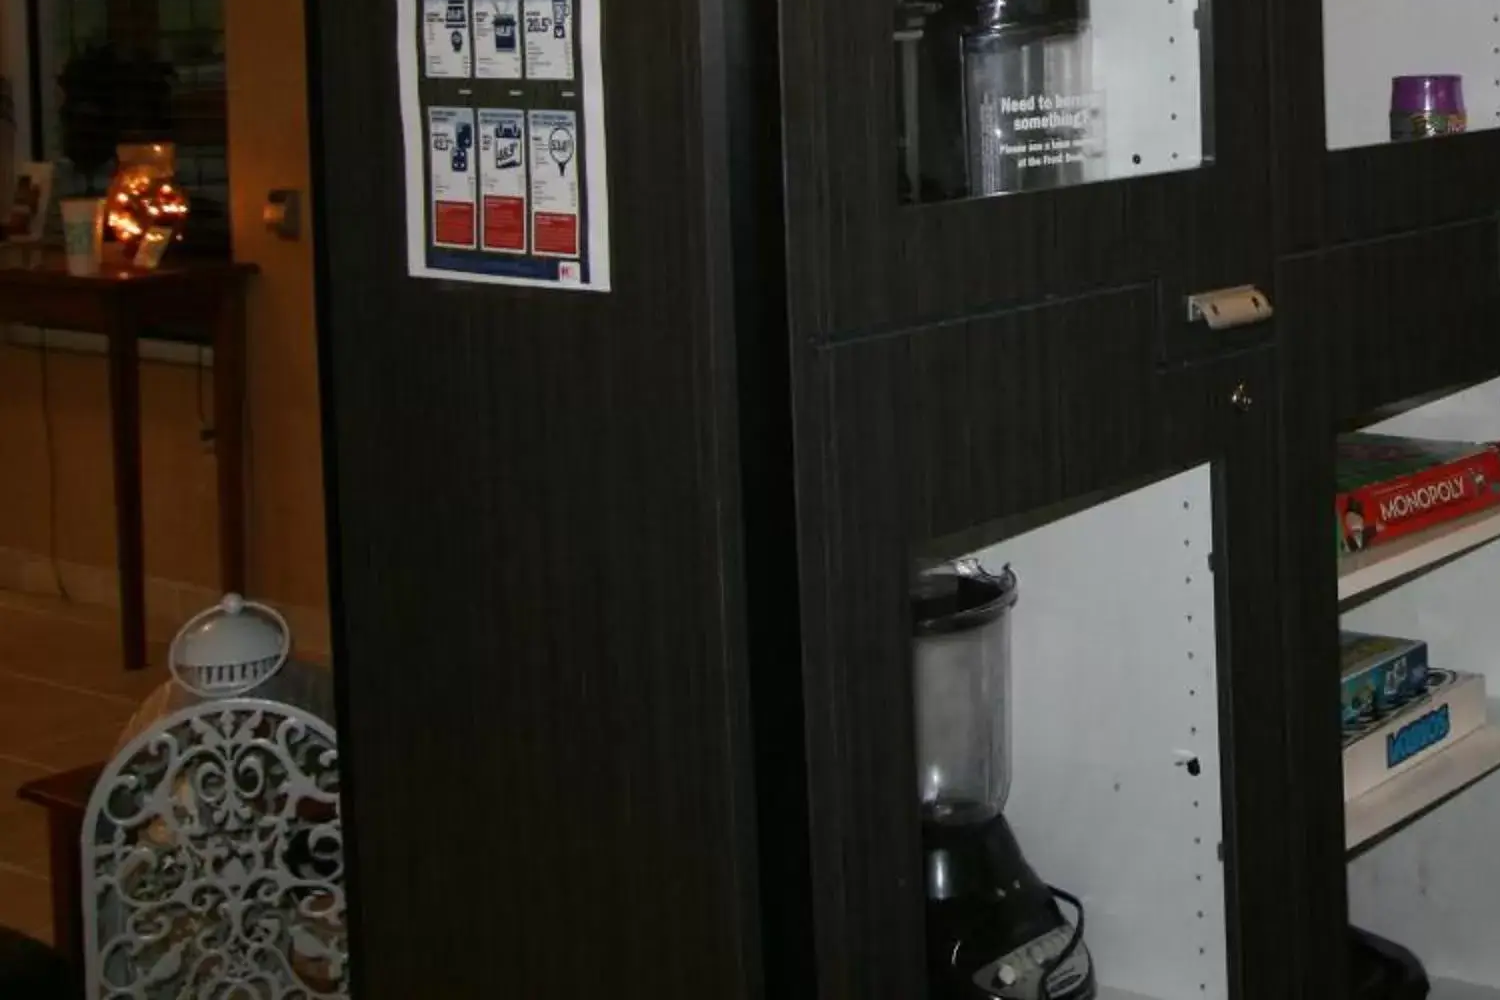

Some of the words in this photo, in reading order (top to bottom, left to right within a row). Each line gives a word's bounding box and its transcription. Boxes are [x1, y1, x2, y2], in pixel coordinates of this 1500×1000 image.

[1001, 96, 1035, 114] Need
[1037, 94, 1053, 111] to
[1380, 475, 1466, 522] MONOPOLY
